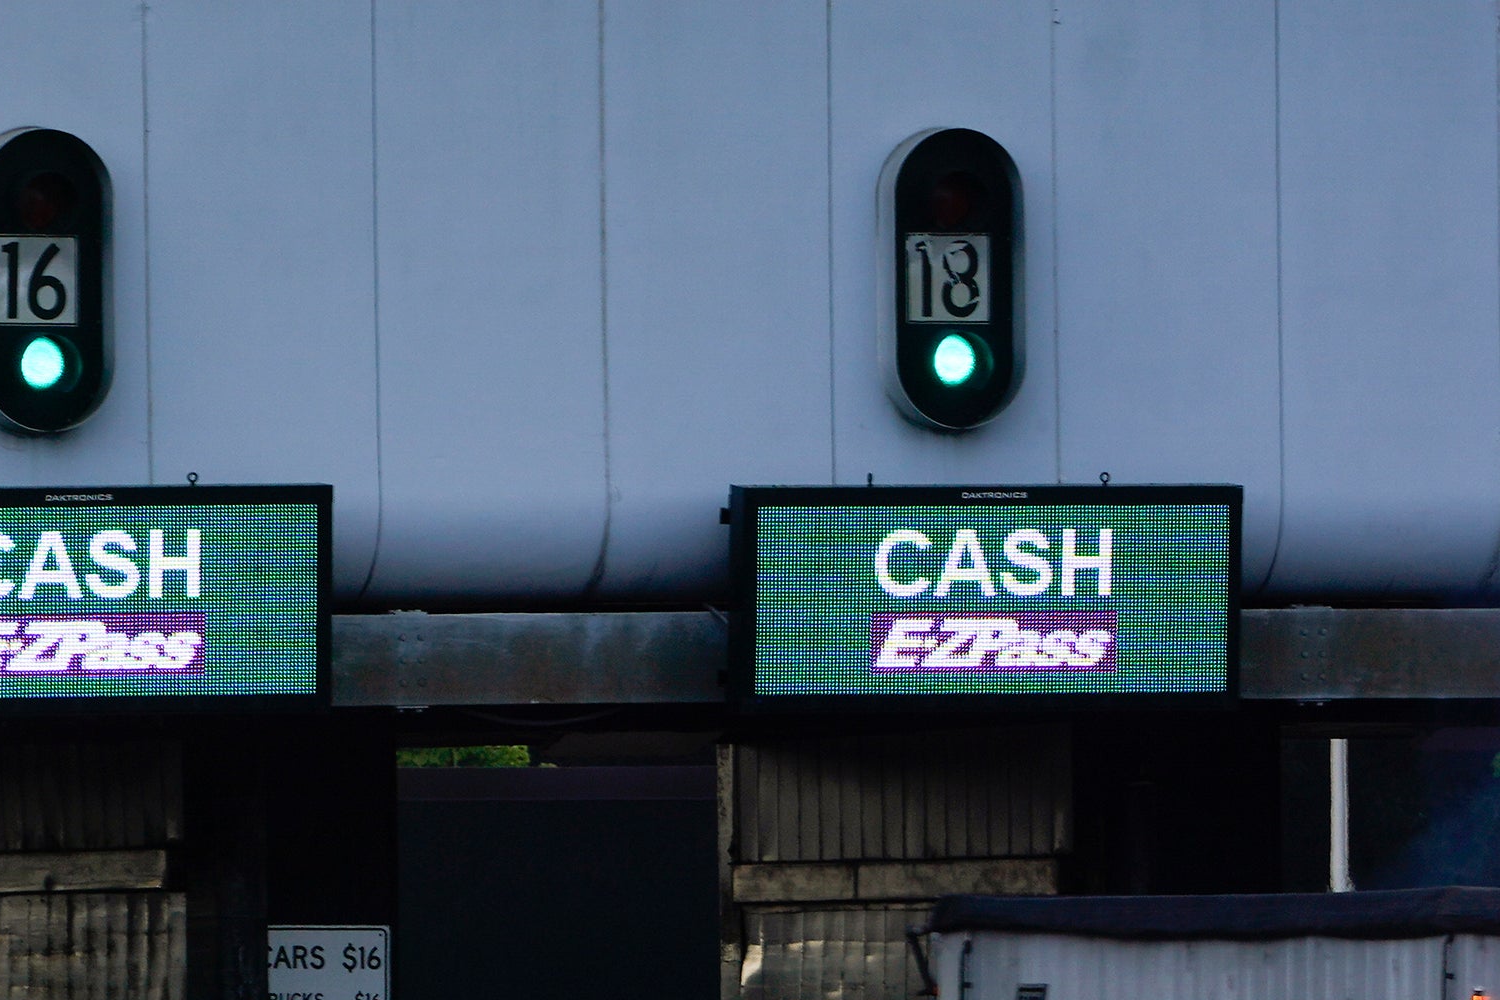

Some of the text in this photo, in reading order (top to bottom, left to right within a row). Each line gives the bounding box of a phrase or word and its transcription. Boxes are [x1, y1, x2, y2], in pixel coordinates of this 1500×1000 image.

[1, 242, 67, 320] 16
[915, 240, 980, 318] 18
[45, 493, 114, 502] DAKTRONICS
[961, 491, 1029, 500] DAKTRONICS
[874, 527, 1114, 598] CASH
[342, 943, 382, 973] $16
